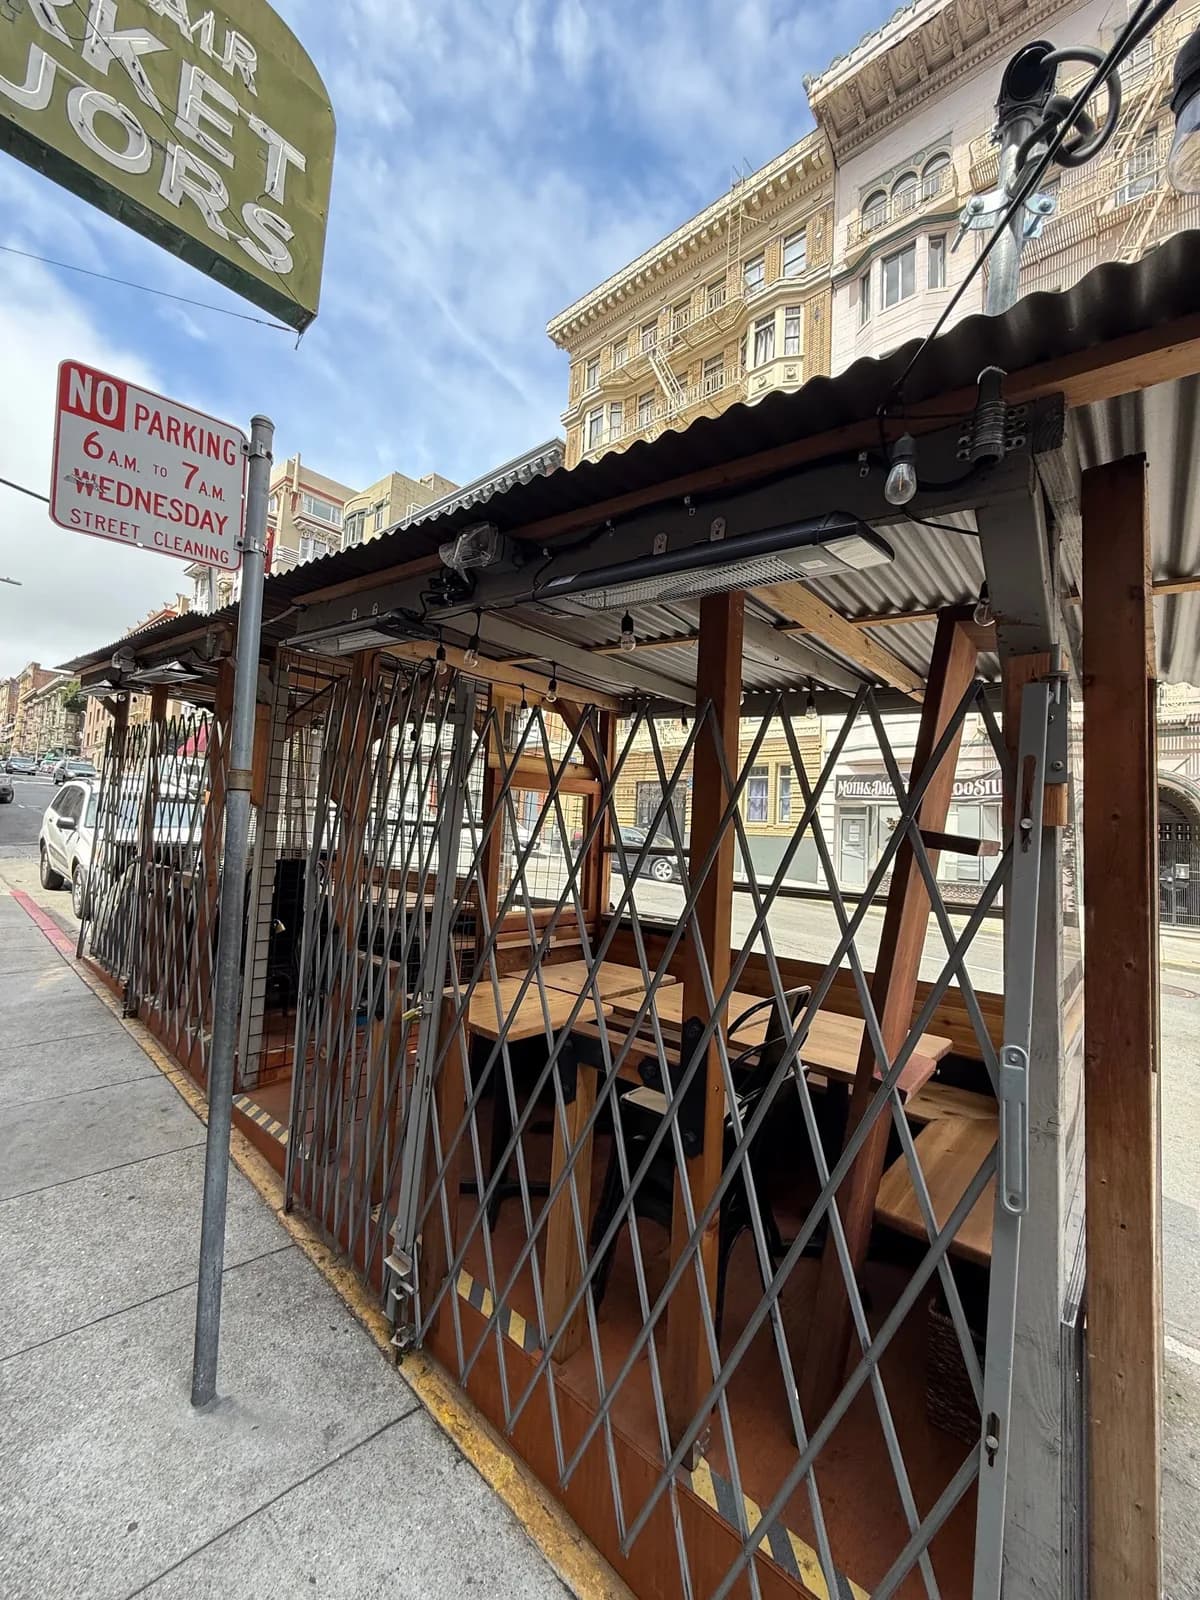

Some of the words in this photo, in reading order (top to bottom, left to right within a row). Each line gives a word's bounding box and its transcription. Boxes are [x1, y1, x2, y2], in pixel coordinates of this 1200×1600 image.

[68, 368, 119, 421] NO
[134, 403, 236, 466] PARKING
[82, 430, 104, 460] 6
[108, 450, 141, 473] A.M.
[153, 463, 168, 478] TO
[182, 461, 200, 490] 7
[198, 481, 225, 502] A.M.
[70, 508, 141, 540] STREET
[153, 531, 229, 564] CLEANING
[73, 467, 229, 536] WEDNESDAY
